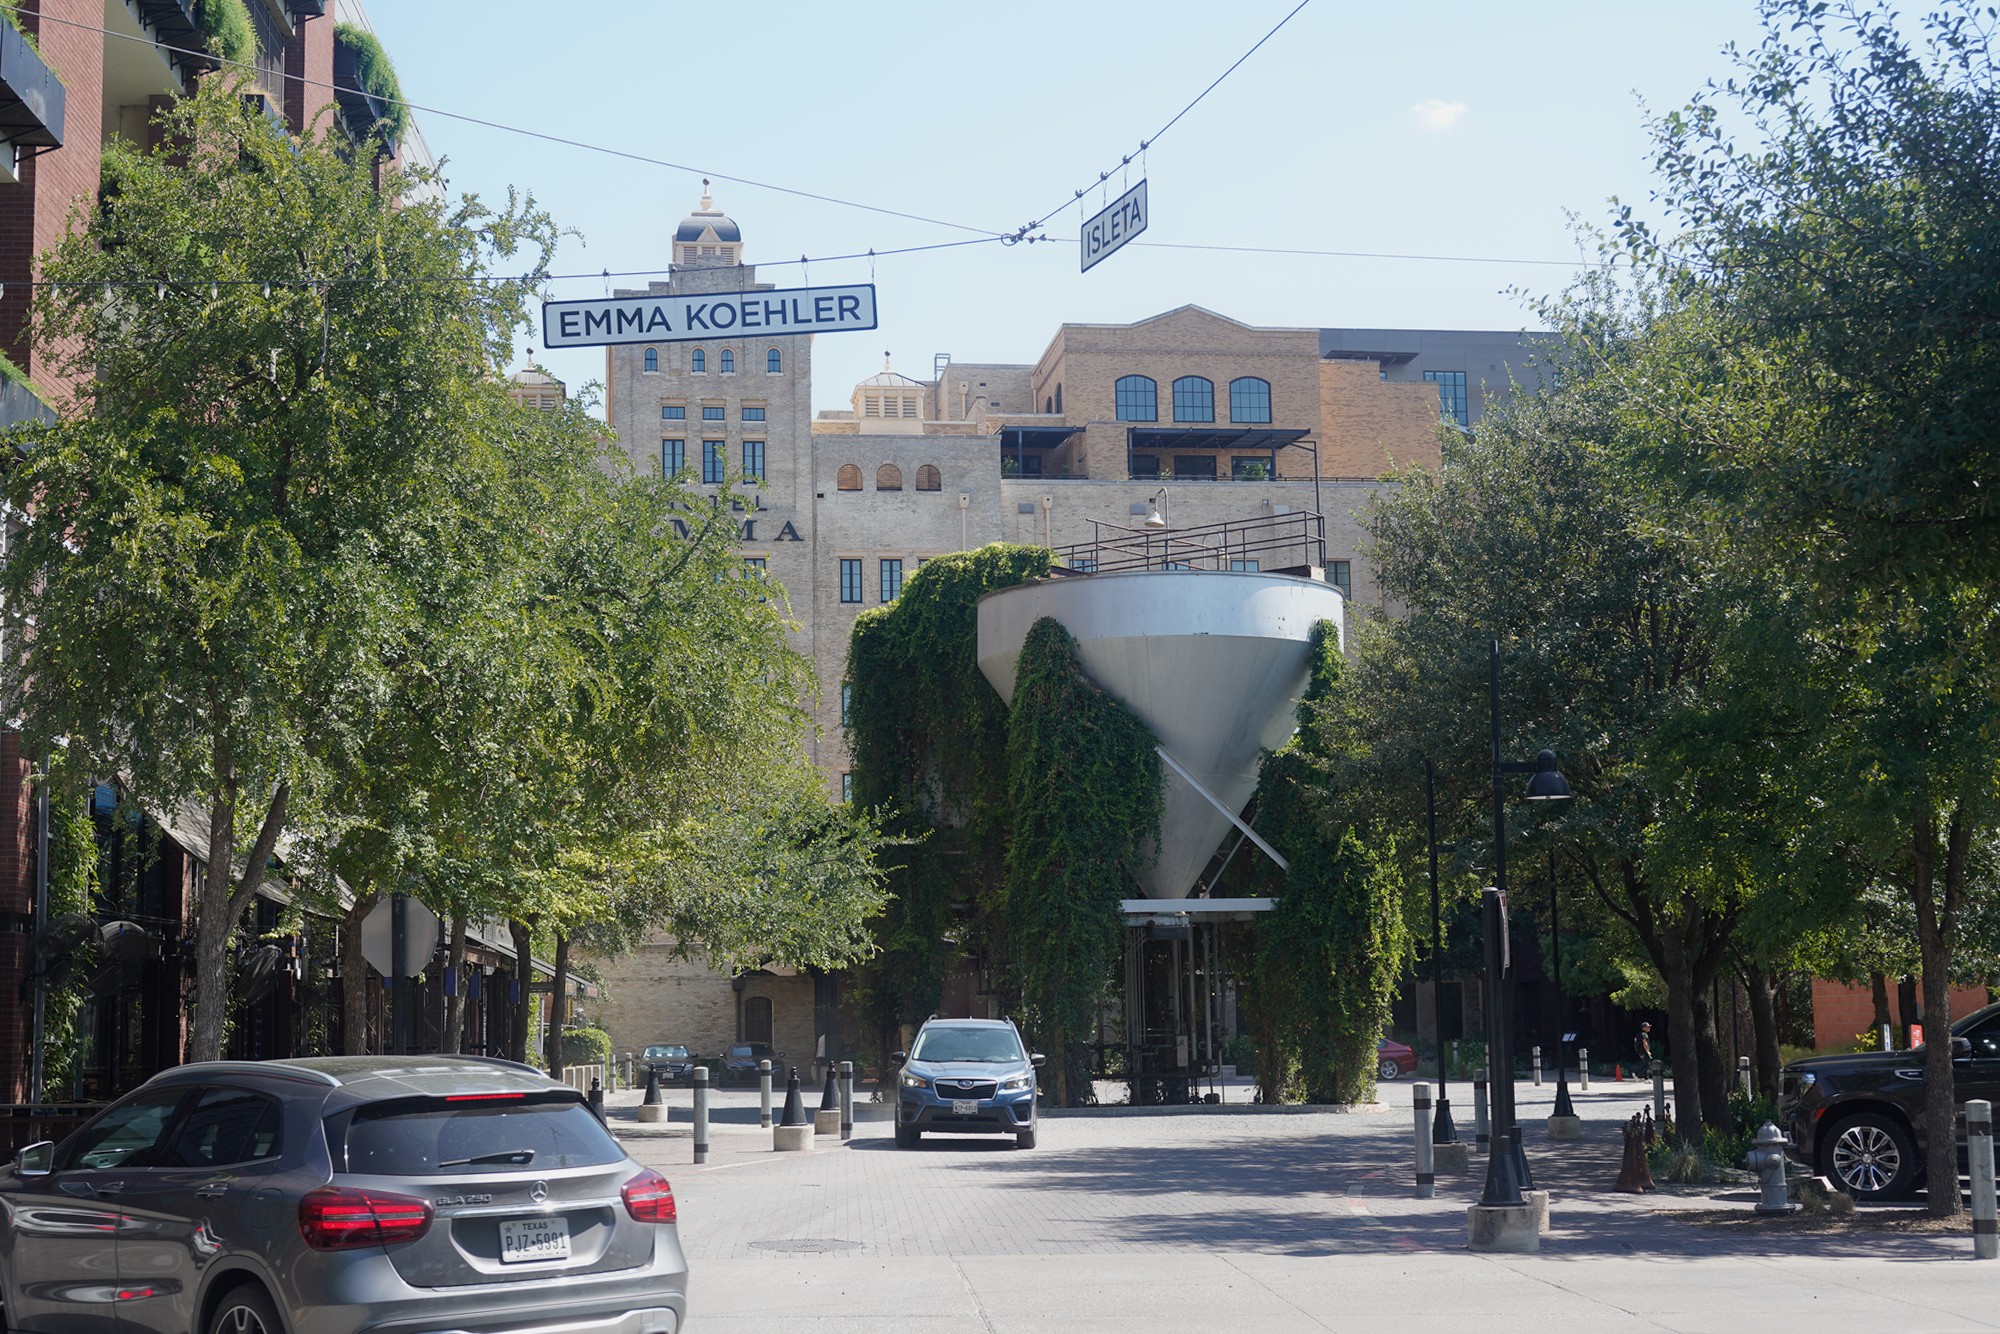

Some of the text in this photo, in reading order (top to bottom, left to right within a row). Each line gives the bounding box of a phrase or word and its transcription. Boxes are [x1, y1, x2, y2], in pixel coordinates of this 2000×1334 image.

[1087, 197, 1142, 259] ISLETA
[560, 295, 862, 338] EMMA KOEHLER
[660, 495, 768, 511] TEL
[522, 1222, 548, 1231] TEXAS
